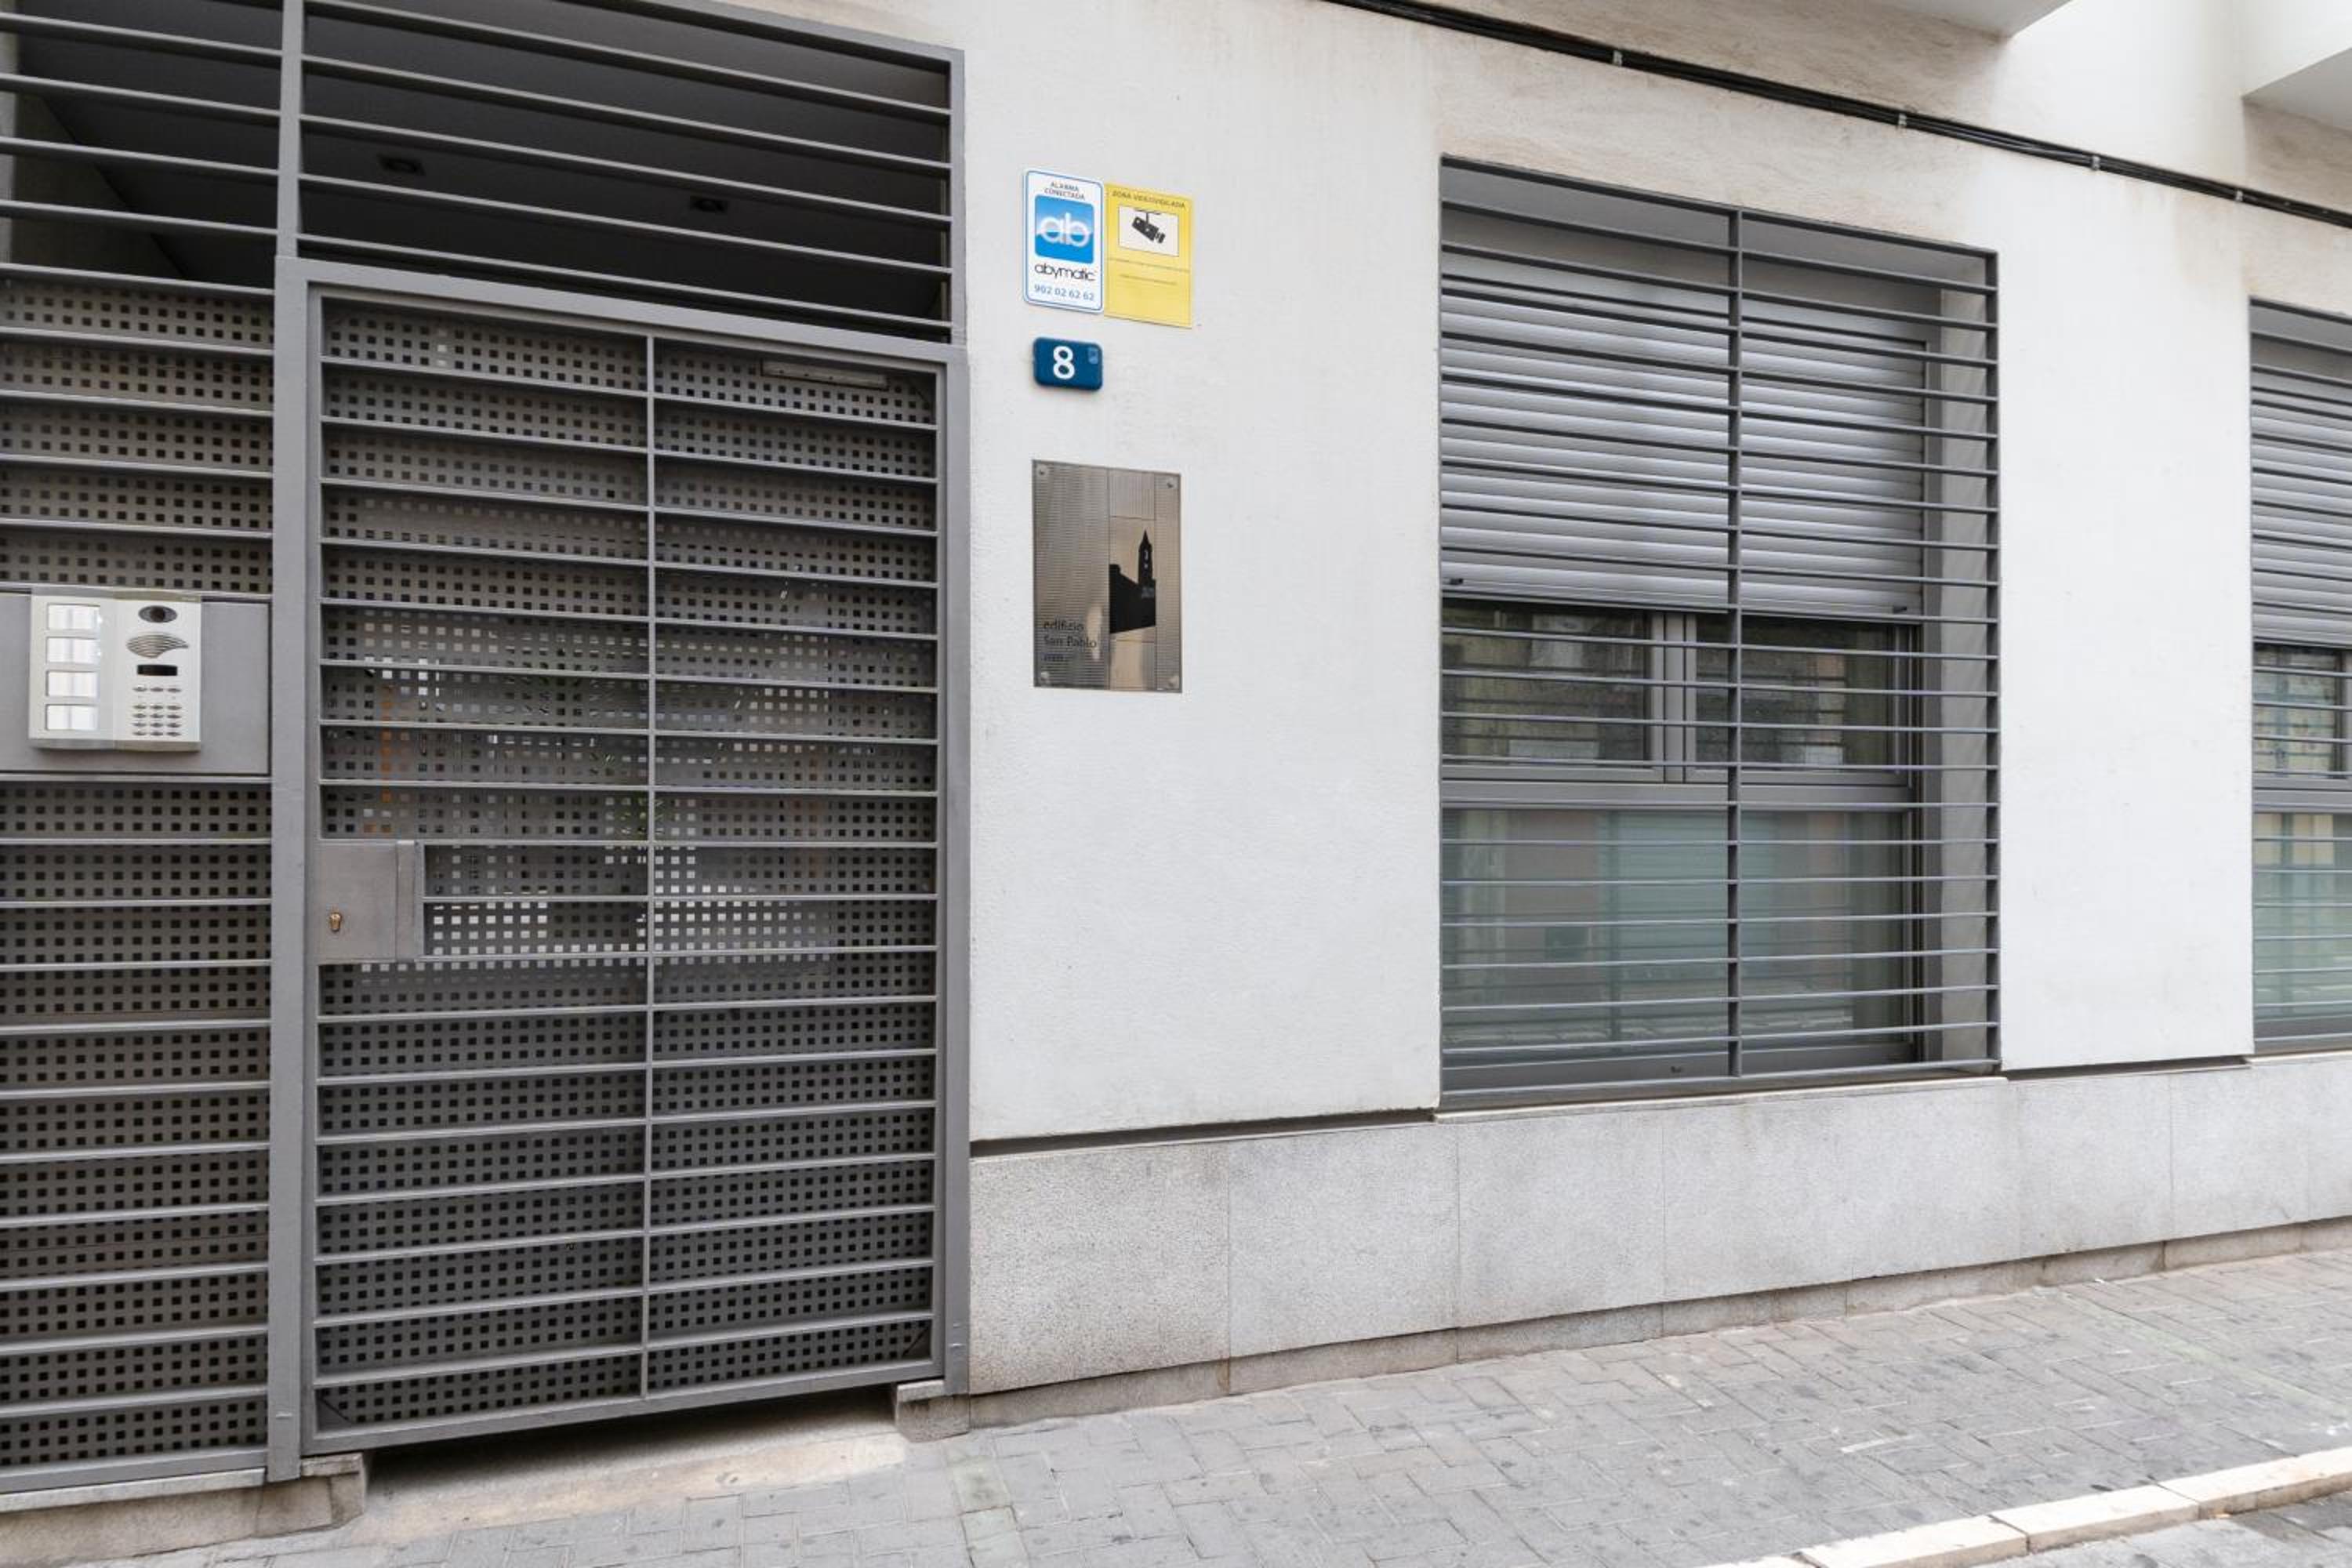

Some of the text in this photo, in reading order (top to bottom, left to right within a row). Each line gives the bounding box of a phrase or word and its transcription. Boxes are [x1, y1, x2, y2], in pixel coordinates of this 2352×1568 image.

[1051, 181, 1079, 191] ALARMA
[1044, 187, 1085, 200] CONECTADA
[1112, 191, 1131, 199] ZONA
[1035, 263, 1095, 281] abymatic
[1034, 284, 1094, 300] 902 02 62 62
[1053, 346, 1075, 379] 8
